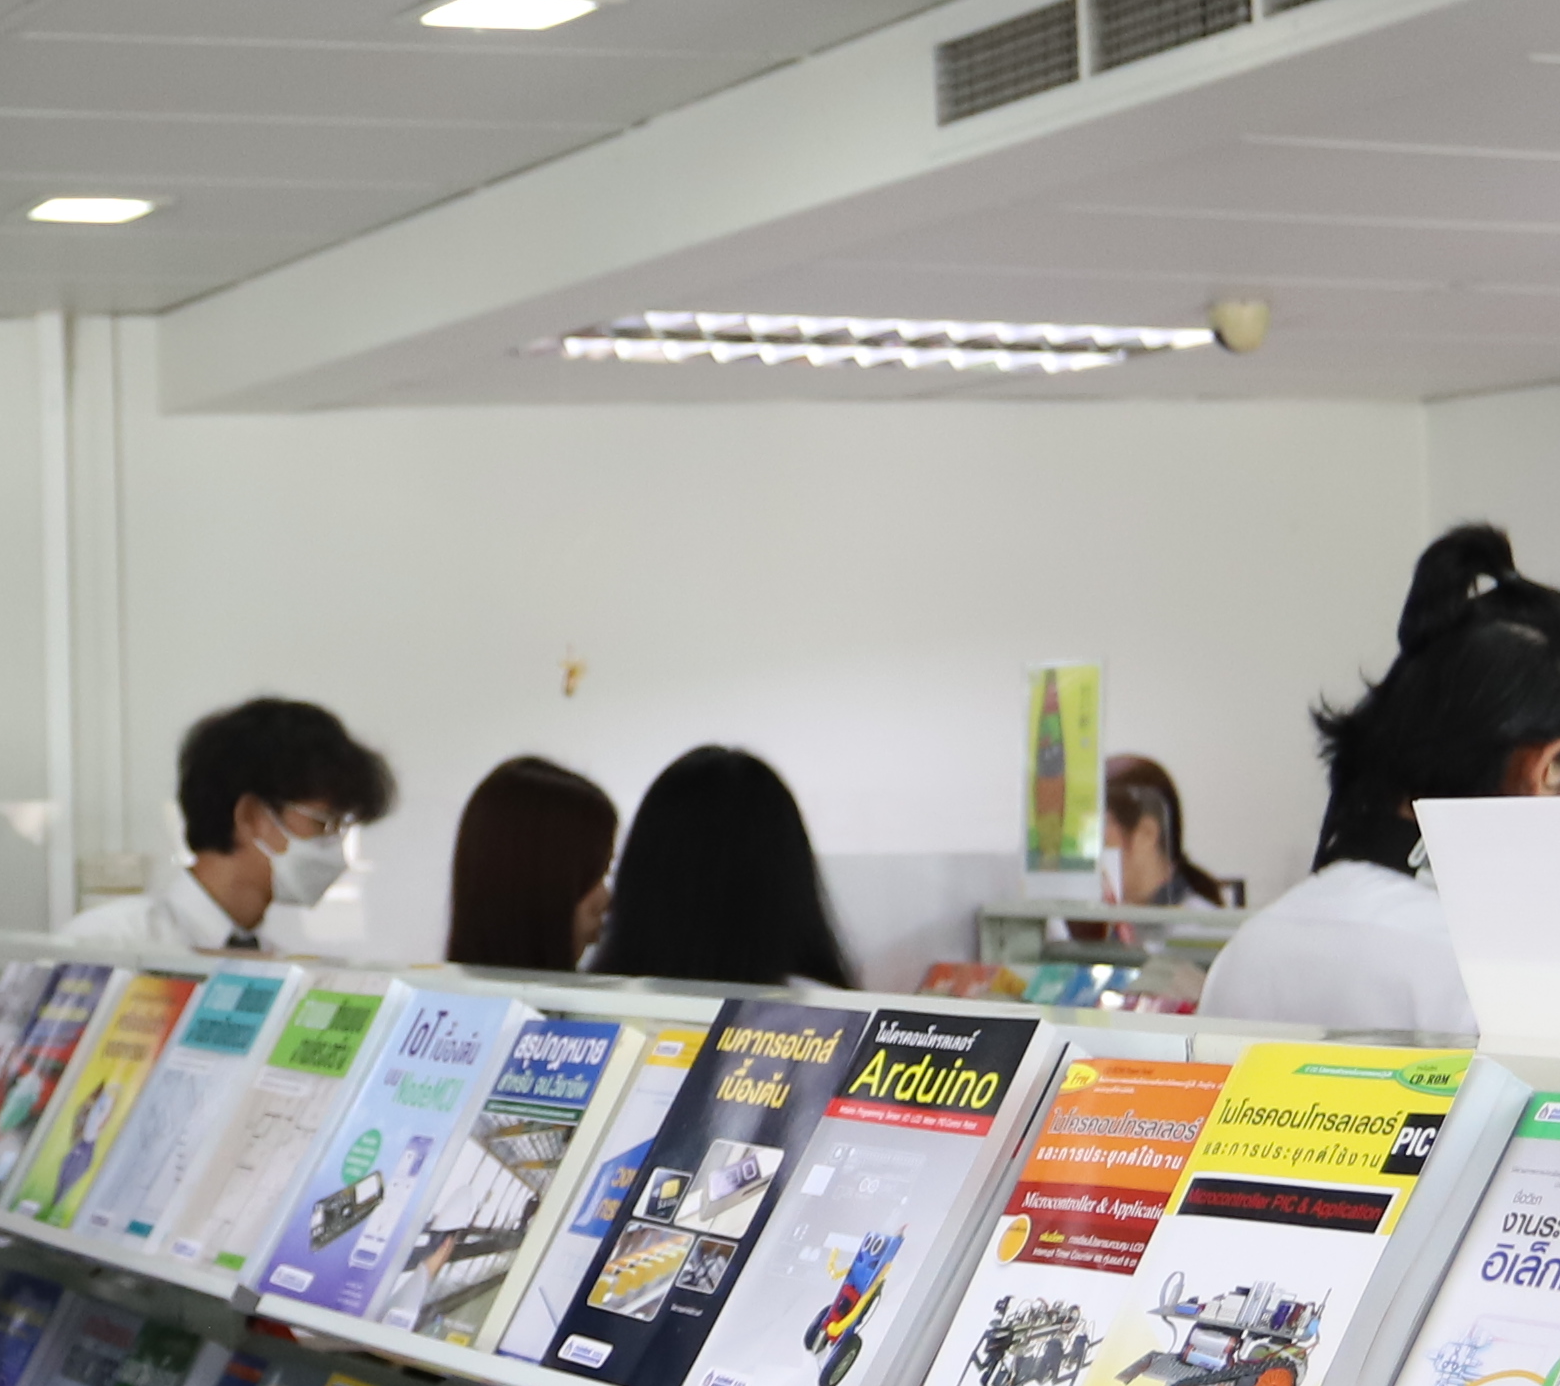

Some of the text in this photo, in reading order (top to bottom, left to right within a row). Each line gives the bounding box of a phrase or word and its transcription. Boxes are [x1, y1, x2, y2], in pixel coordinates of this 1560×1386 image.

[398, 1007, 449, 1058] IoT
[716, 1026, 843, 1065] เมคาทรอนิกส์
[874, 1020, 982, 1052] ไมโครคอนโทรลเลอร์
[512, 1030, 611, 1071] สรุปกฎหมาย
[716, 1059, 791, 1109] เบื้องต้น
[848, 1048, 1000, 1110] Arduino
[1409, 1072, 1451, 1086] CD-ROM
[1047, 1106, 1204, 1143] ไมโครคอนโทรลเลอร์
[1217, 1098, 1403, 1136] ไมโครคอนโทรลเลอร์
[1036, 1144, 1184, 1170] และการประยุกต์ใช้งาน
[1202, 1141, 1382, 1168] และการประยุกต์ใช้งาน
[1391, 1126, 1436, 1157] PIC
[1021, 1190, 1166, 1220] Microcontroller & Applicatio
[1185, 1187, 1382, 1222] Microcontroller PIC & Application
[1513, 1189, 1543, 1206] ชื่อวิชา
